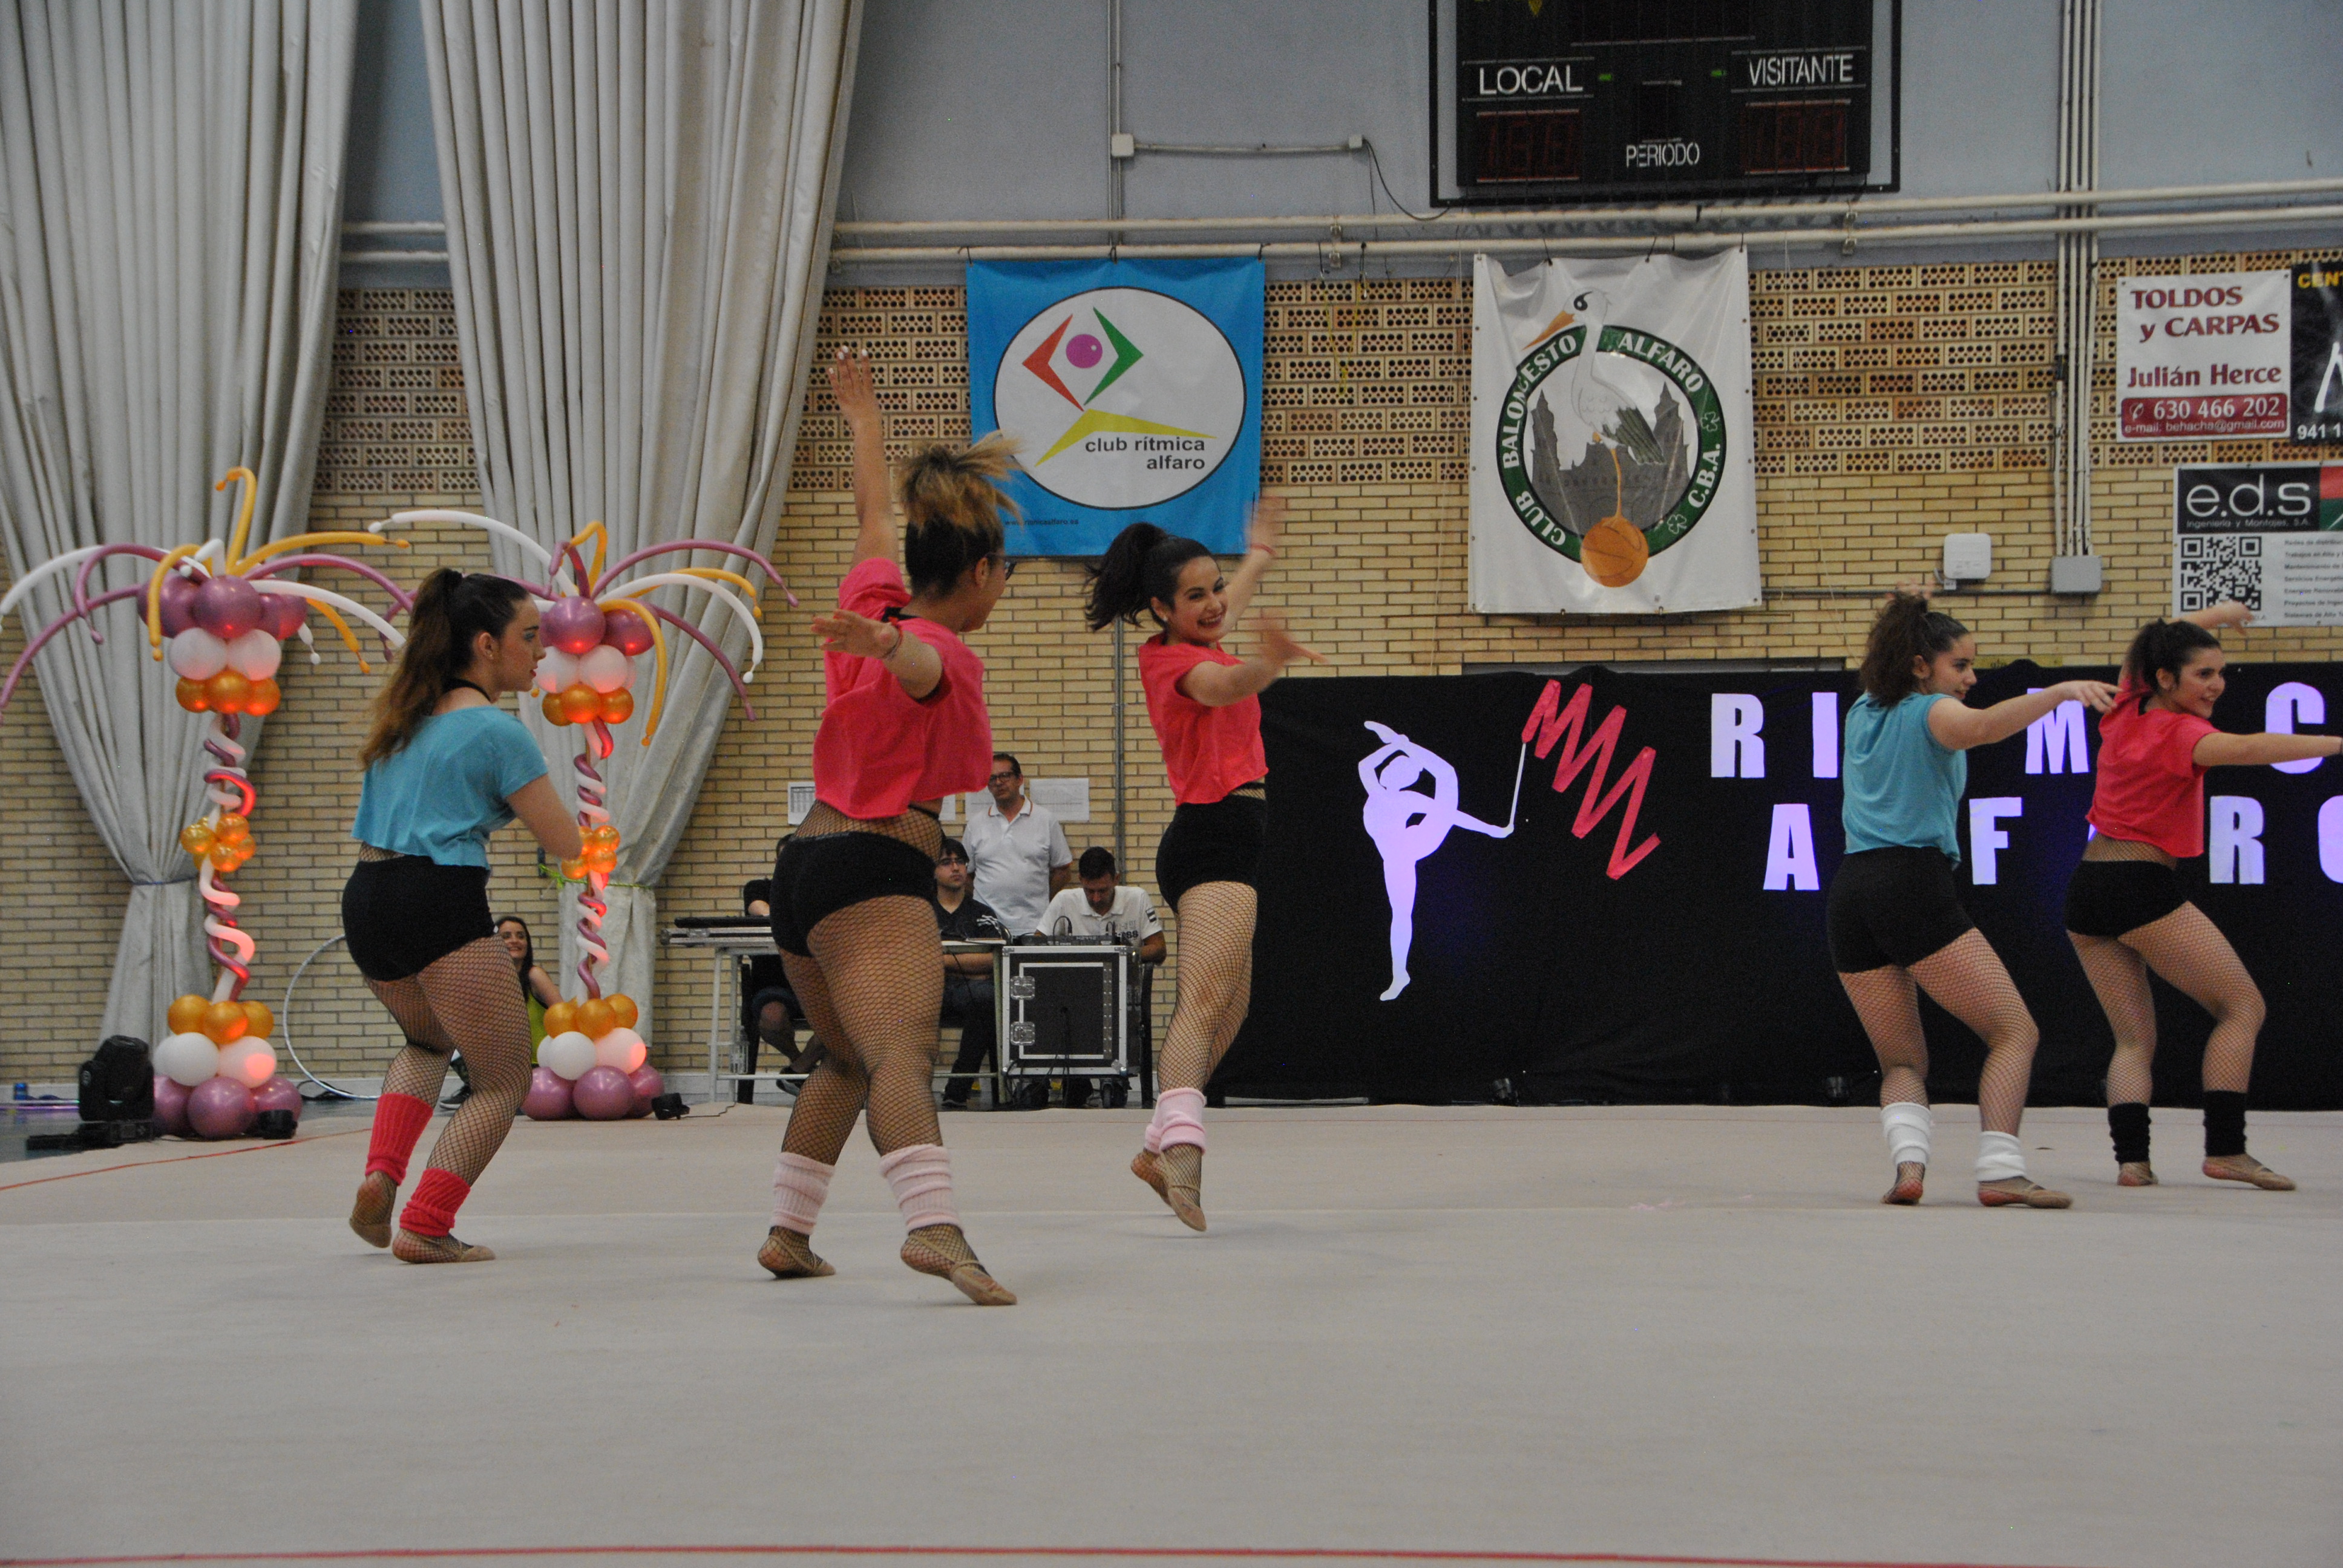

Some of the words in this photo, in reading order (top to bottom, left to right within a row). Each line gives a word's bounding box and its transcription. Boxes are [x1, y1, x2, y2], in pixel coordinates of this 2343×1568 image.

[1479, 64, 1584, 95] LOCAL
[1748, 54, 1854, 87] VISITANTE
[1626, 142, 1700, 168] PERIODO
[2297, 270, 2343, 289] CEN
[2129, 286, 2244, 310] TOLDOS
[2139, 323, 2157, 344] y
[2164, 313, 2280, 337] CARPAS
[1618, 332, 1705, 393] ALFARO
[2127, 365, 2201, 388] Julián
[2210, 363, 2282, 386] Herce
[2153, 399, 2191, 420] 630
[2198, 398, 2235, 419] 466
[2243, 396, 2279, 417] 202
[1085, 436, 1127, 452] club
[1134, 436, 1205, 452] rítmica
[2297, 423, 2326, 441] 941
[1146, 455, 1205, 470] alfaro
[1688, 443, 1721, 509] C.B.A.
[1515, 490, 1566, 546] CLUB
